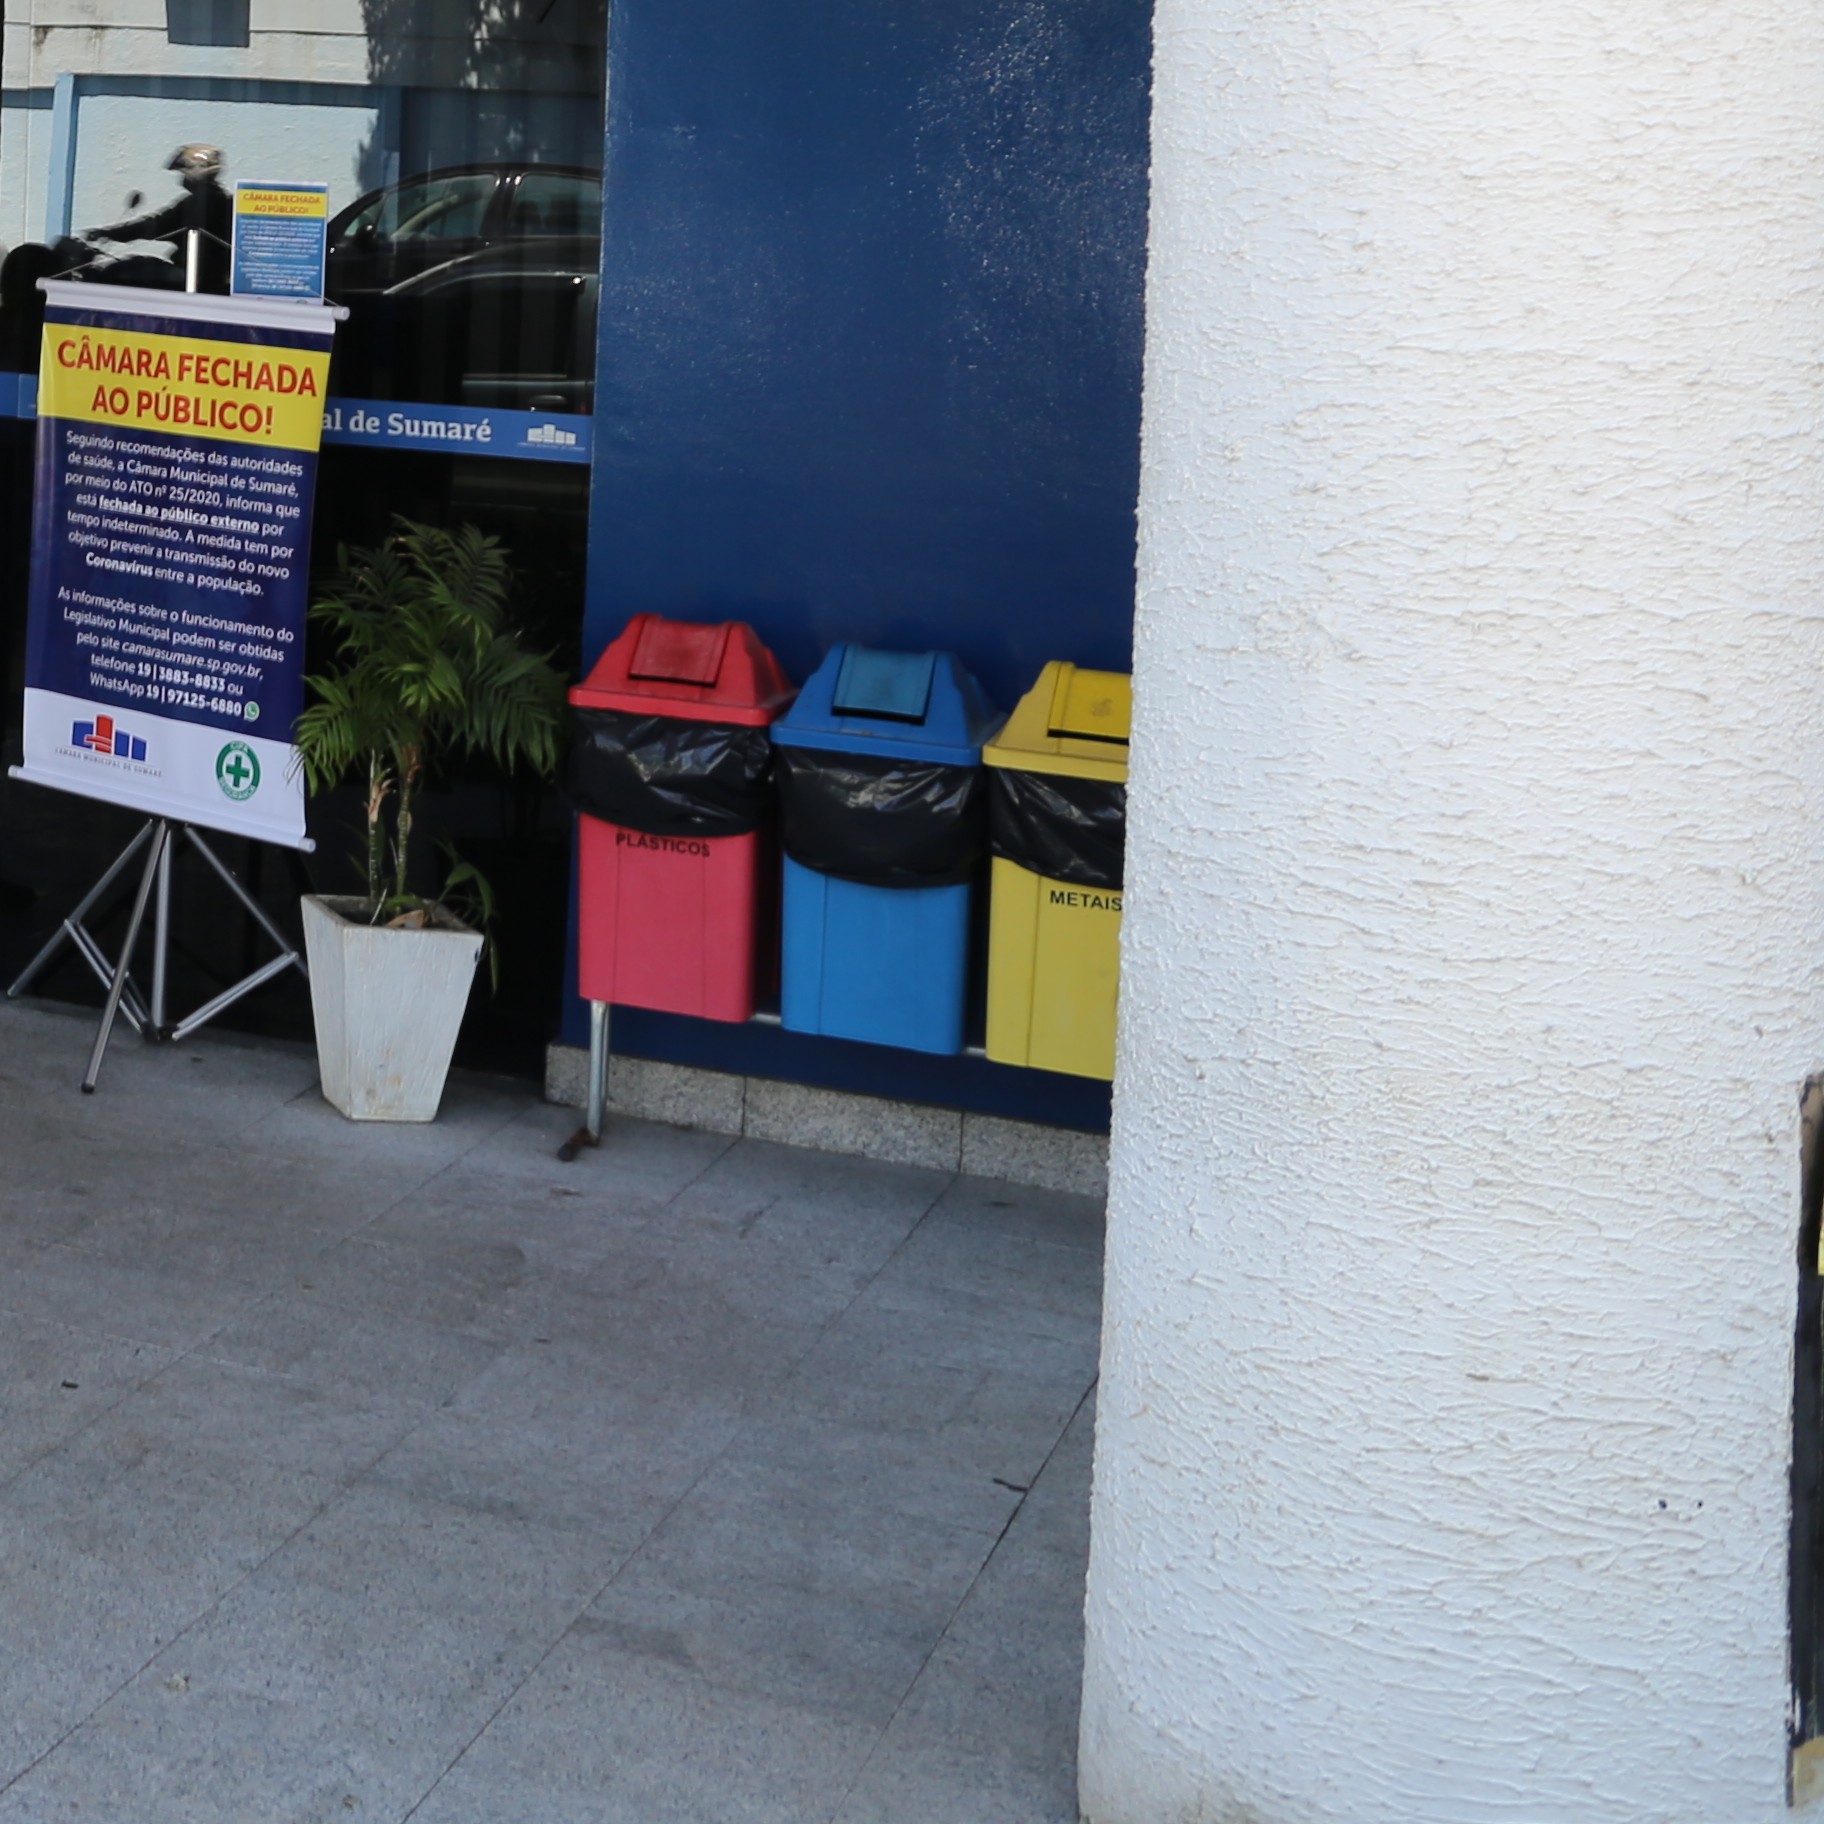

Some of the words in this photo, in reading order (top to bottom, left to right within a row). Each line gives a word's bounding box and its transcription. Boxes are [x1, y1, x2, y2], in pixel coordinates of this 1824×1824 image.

[57, 335, 170, 380] CÂMARA
[177, 353, 317, 397] FECHADA
[91, 385, 130, 416] AO
[136, 386, 273, 434] PÚBLICO!
[349, 410, 380, 434] de
[387, 413, 492, 442] Sumaré
[67, 430, 114, 450] Seguindo
[116, 441, 204, 464] recomendações
[208, 451, 228, 465] das
[231, 455, 303, 476] autoridades
[68, 452, 81, 463] de
[84, 454, 115, 471] saúde,
[117, 461, 124, 471] a
[127, 459, 167, 478] Câmara
[170, 469, 228, 488] Municipal
[231, 475, 245, 489] de
[249, 477, 298, 498] Sumaré,
[65, 472, 83, 485] por
[86, 475, 110, 489] meio
[113, 478, 127, 490] do
[130, 481, 152, 495] ATO
[170, 487, 223, 508] 25/2020,
[226, 494, 272, 514] informa
[276, 504, 300, 519] que
[77, 494, 97, 506] está
[99, 495, 142, 514] fechada
[145, 504, 158, 517] ao
[161, 505, 207, 525] público
[210, 515, 259, 532] externo
[262, 522, 284, 537] por
[68, 511, 100, 528] tempo
[103, 514, 182, 541] indeterminado.
[185, 530, 194, 543] A
[197, 532, 241, 551] medida
[244, 540, 268, 556] tem
[271, 545, 294, 559] por
[68, 531, 108, 549] objetivo
[110, 539, 153, 557] prevenir
[156, 548, 162, 557] a
[165, 548, 235, 570] transmissão
[239, 559, 254, 572] do
[257, 565, 289, 580] novo
[86, 552, 152, 577] Coronavírus
[155, 567, 184, 581] entre
[187, 573, 194, 583] a
[198, 573, 264, 595] população.
[58, 586, 70, 601] As
[73, 588, 135, 614] informações
[139, 602, 167, 620] sobre
[170, 611, 178, 621] o
[182, 610, 274, 639] funcionamento
[277, 627, 294, 643] do
[64, 607, 116, 629] Legislativo
[119, 619, 169, 640] Municipal
[173, 631, 215, 649] podem
[218, 641, 236, 652] ser
[239, 644, 284, 662] obtidas
[77, 632, 99, 645] pelo
[102, 636, 120, 649] site
[90, 672, 144, 697] WhatsApp
[92, 654, 135, 674] telefone
[227, 682, 243, 695] ou
[1050, 890, 1122, 911] METAIS
